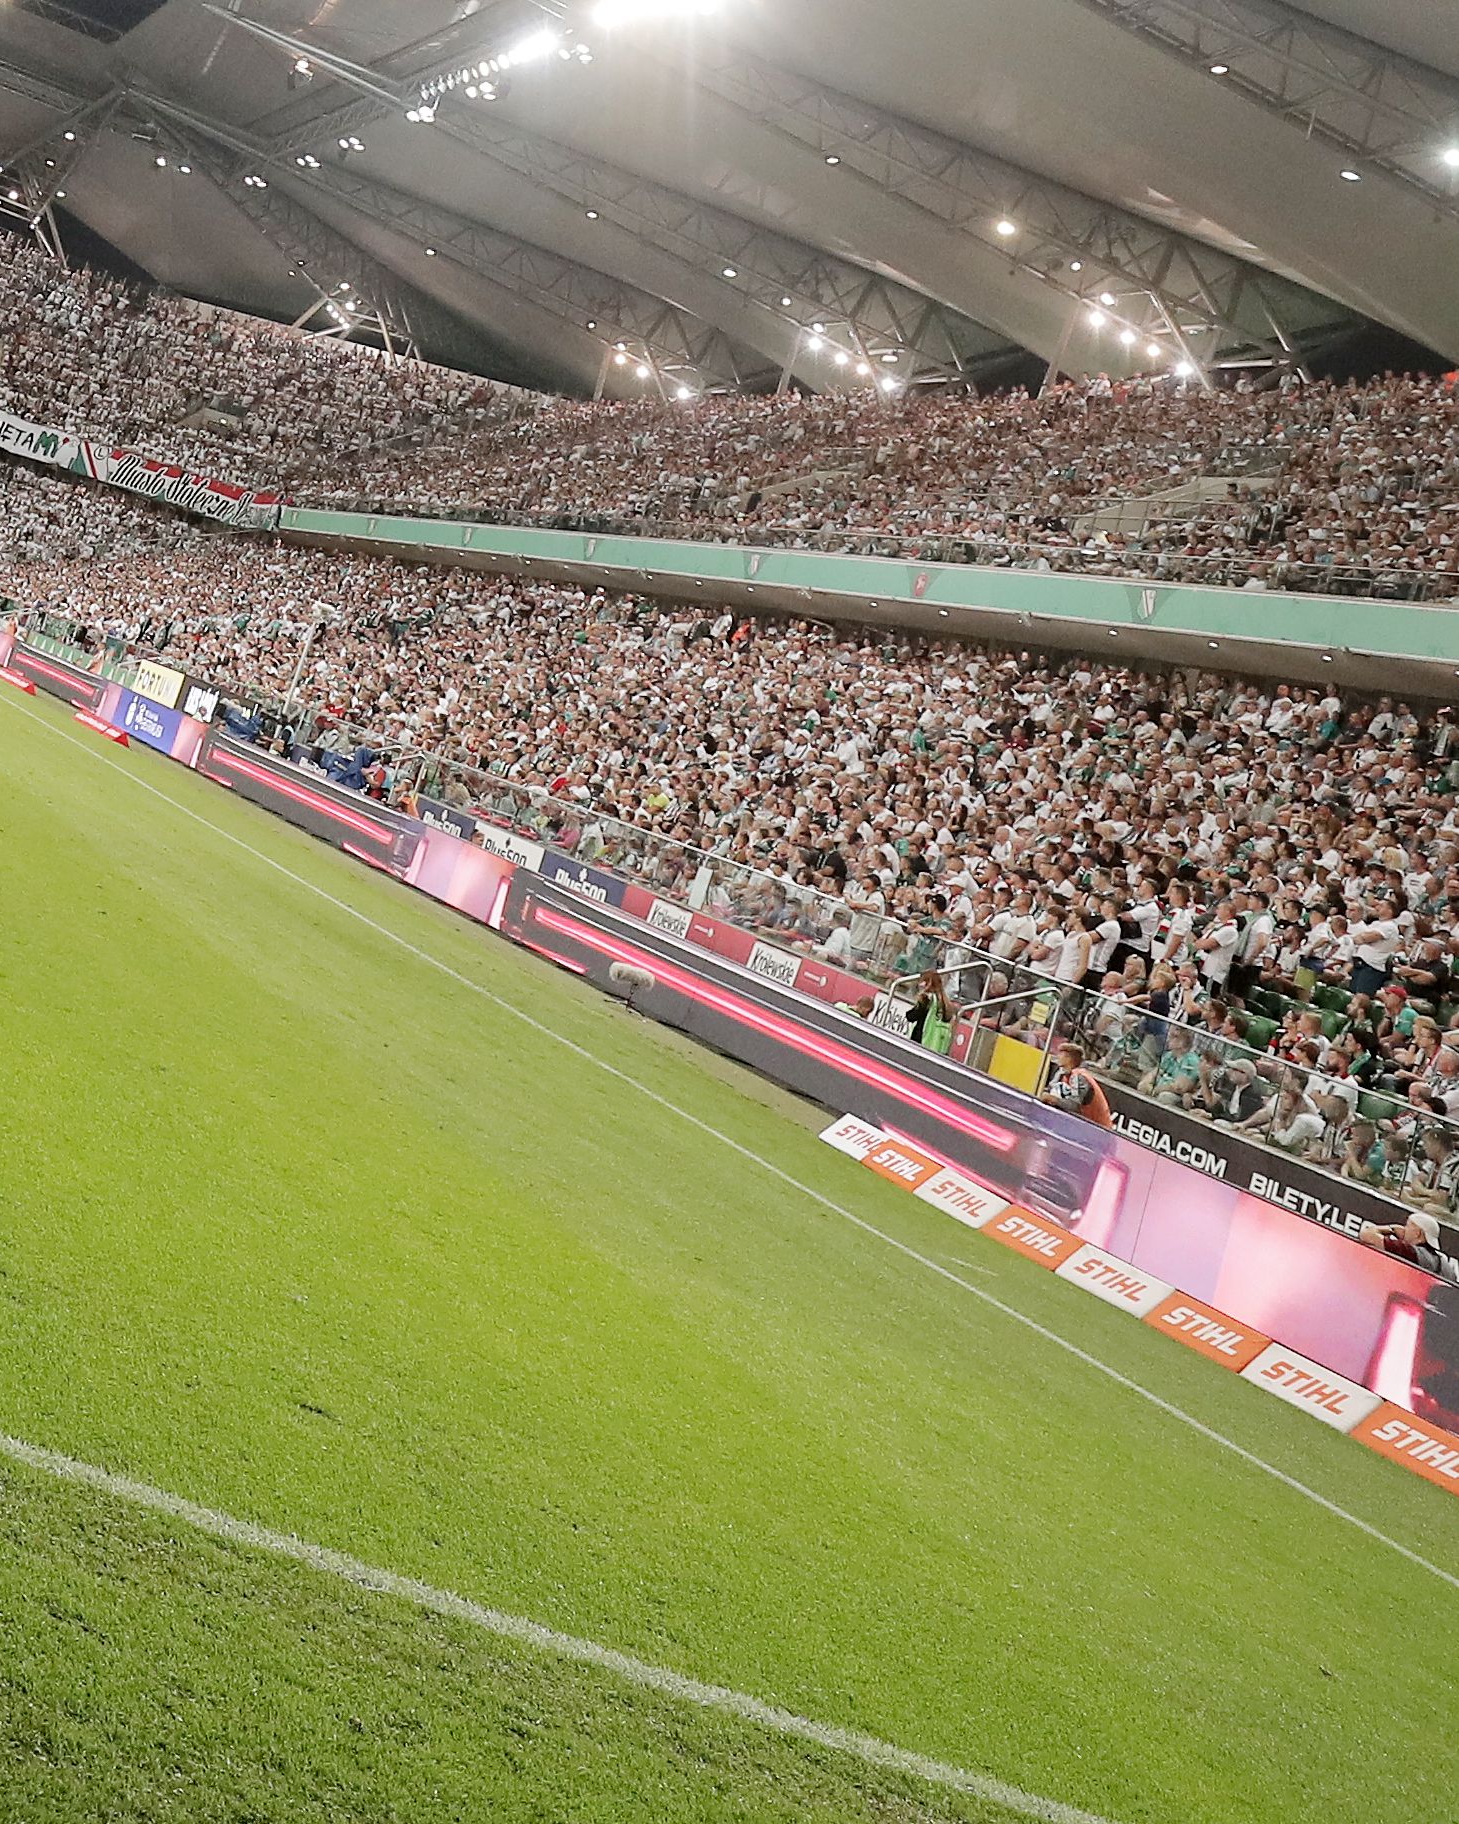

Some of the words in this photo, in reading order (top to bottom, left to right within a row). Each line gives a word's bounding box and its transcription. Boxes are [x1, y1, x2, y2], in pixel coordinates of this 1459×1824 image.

[555, 868, 608, 903] Plus500
[872, 1149, 925, 1182] STIHL
[931, 1180, 988, 1218] STIHL
[996, 1216, 1063, 1257] STIHL
[1074, 1258, 1147, 1303] STIHL
[1161, 1306, 1245, 1356] STIHL
[1260, 1360, 1350, 1415] STIHL
